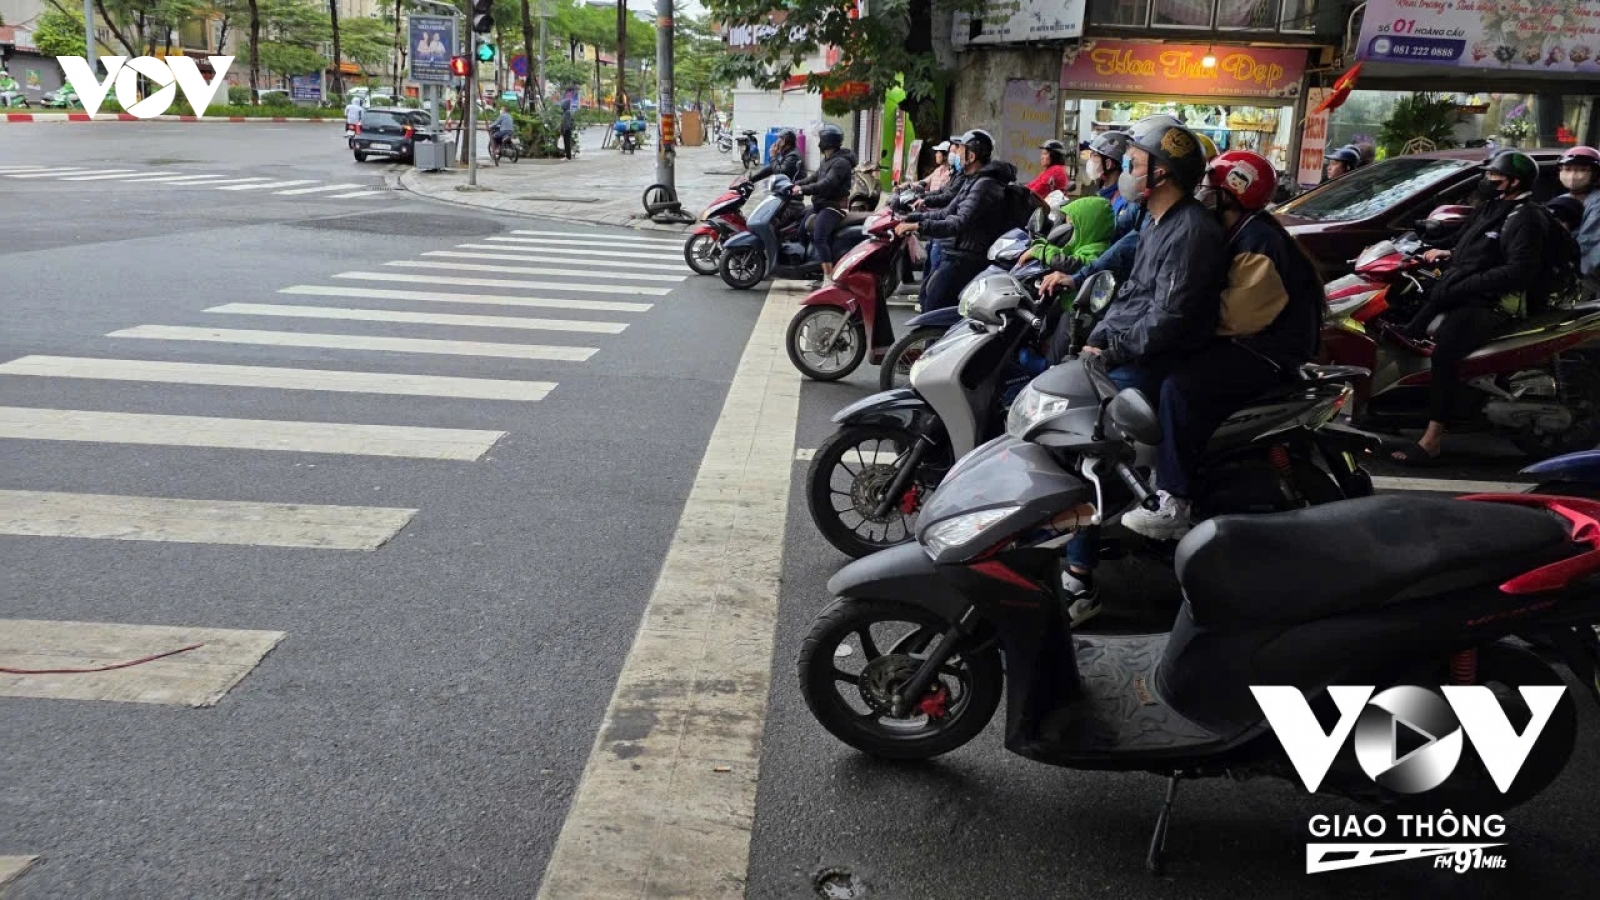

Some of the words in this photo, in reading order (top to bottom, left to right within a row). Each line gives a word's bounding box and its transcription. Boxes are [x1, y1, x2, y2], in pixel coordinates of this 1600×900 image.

[1392, 18, 1415, 34] 01
[1393, 44, 1410, 55] 081
[1411, 46, 1430, 56] 222
[1430, 47, 1454, 58] 0888
[1091, 50, 1155, 76] Hoa
